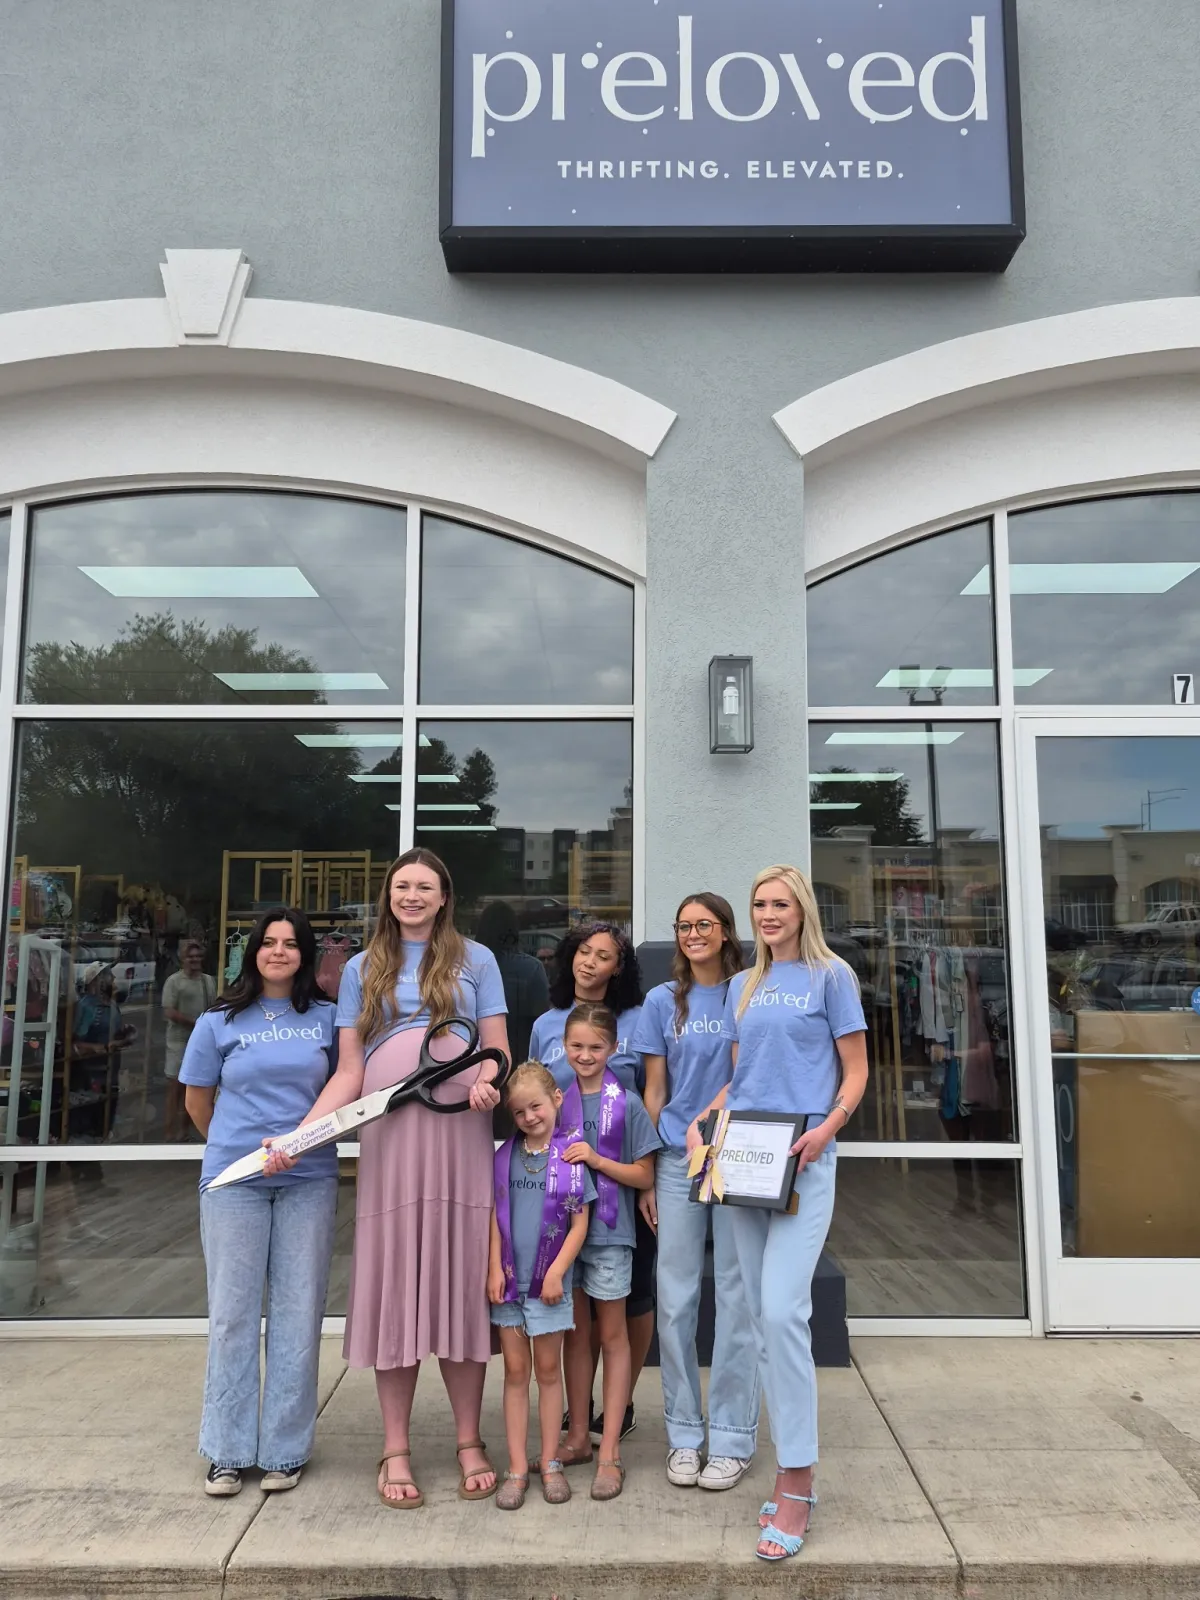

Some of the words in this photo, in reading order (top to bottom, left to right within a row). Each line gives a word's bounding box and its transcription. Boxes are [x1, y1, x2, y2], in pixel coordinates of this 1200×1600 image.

[471, 15, 988, 158] preloved
[557, 160, 730, 180] THRIFTING.
[747, 160, 905, 180] ELEVATED.
[1176, 675, 1191, 703] 7
[749, 991, 812, 1009] eloved
[240, 1021, 323, 1049] preloved
[281, 1138, 300, 1152] Davis
[301, 1120, 332, 1141] Chamber
[299, 1127, 335, 1149] Commerce
[721, 1149, 774, 1165] PRELOVED
